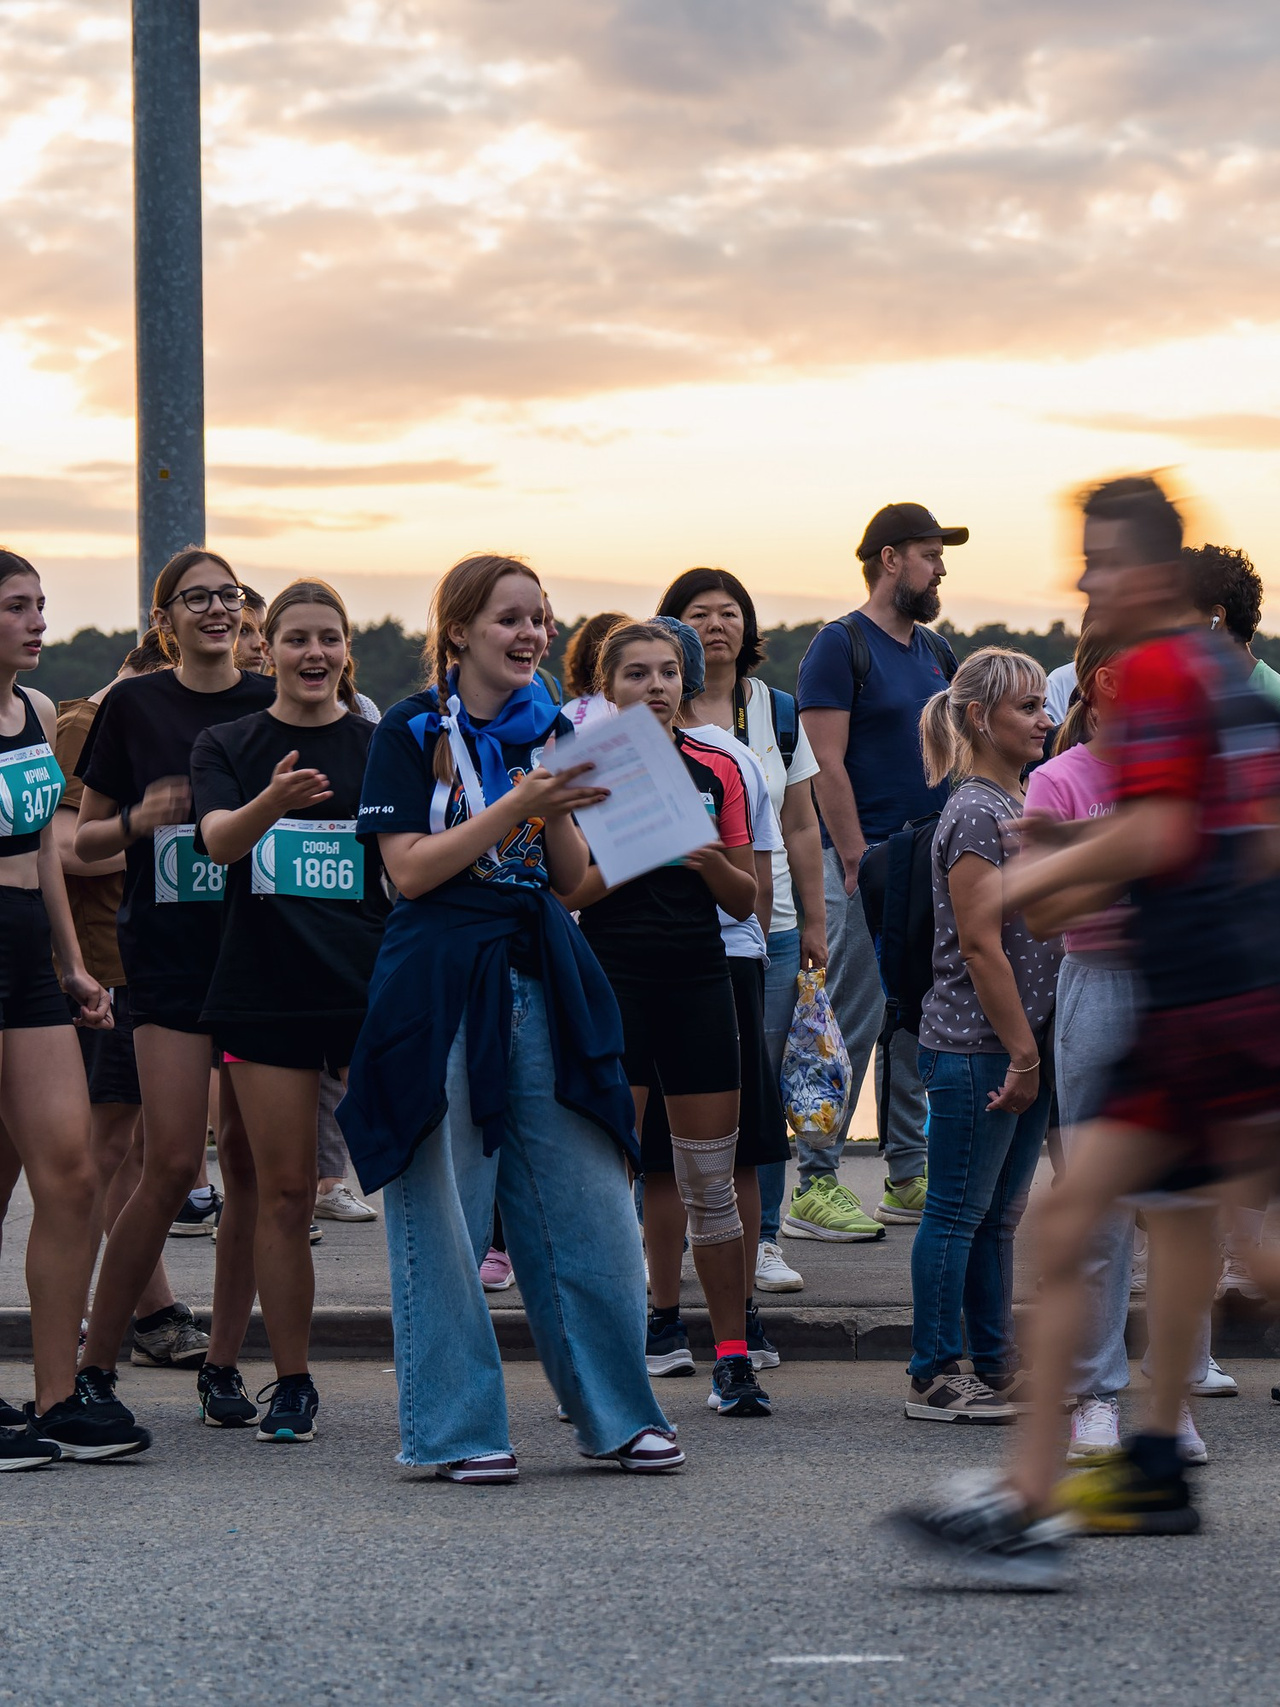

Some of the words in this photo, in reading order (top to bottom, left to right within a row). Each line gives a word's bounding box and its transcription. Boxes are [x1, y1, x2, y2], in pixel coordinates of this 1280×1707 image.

[737, 707, 746, 730] Nikon
[23, 766, 51, 785] ИРИНА
[22, 782, 62, 823] 3477
[381, 805, 395, 814] 40
[302, 840, 341, 854] СОФЬЯ
[191, 861, 229, 892] 28
[292, 857, 354, 890] 1866
